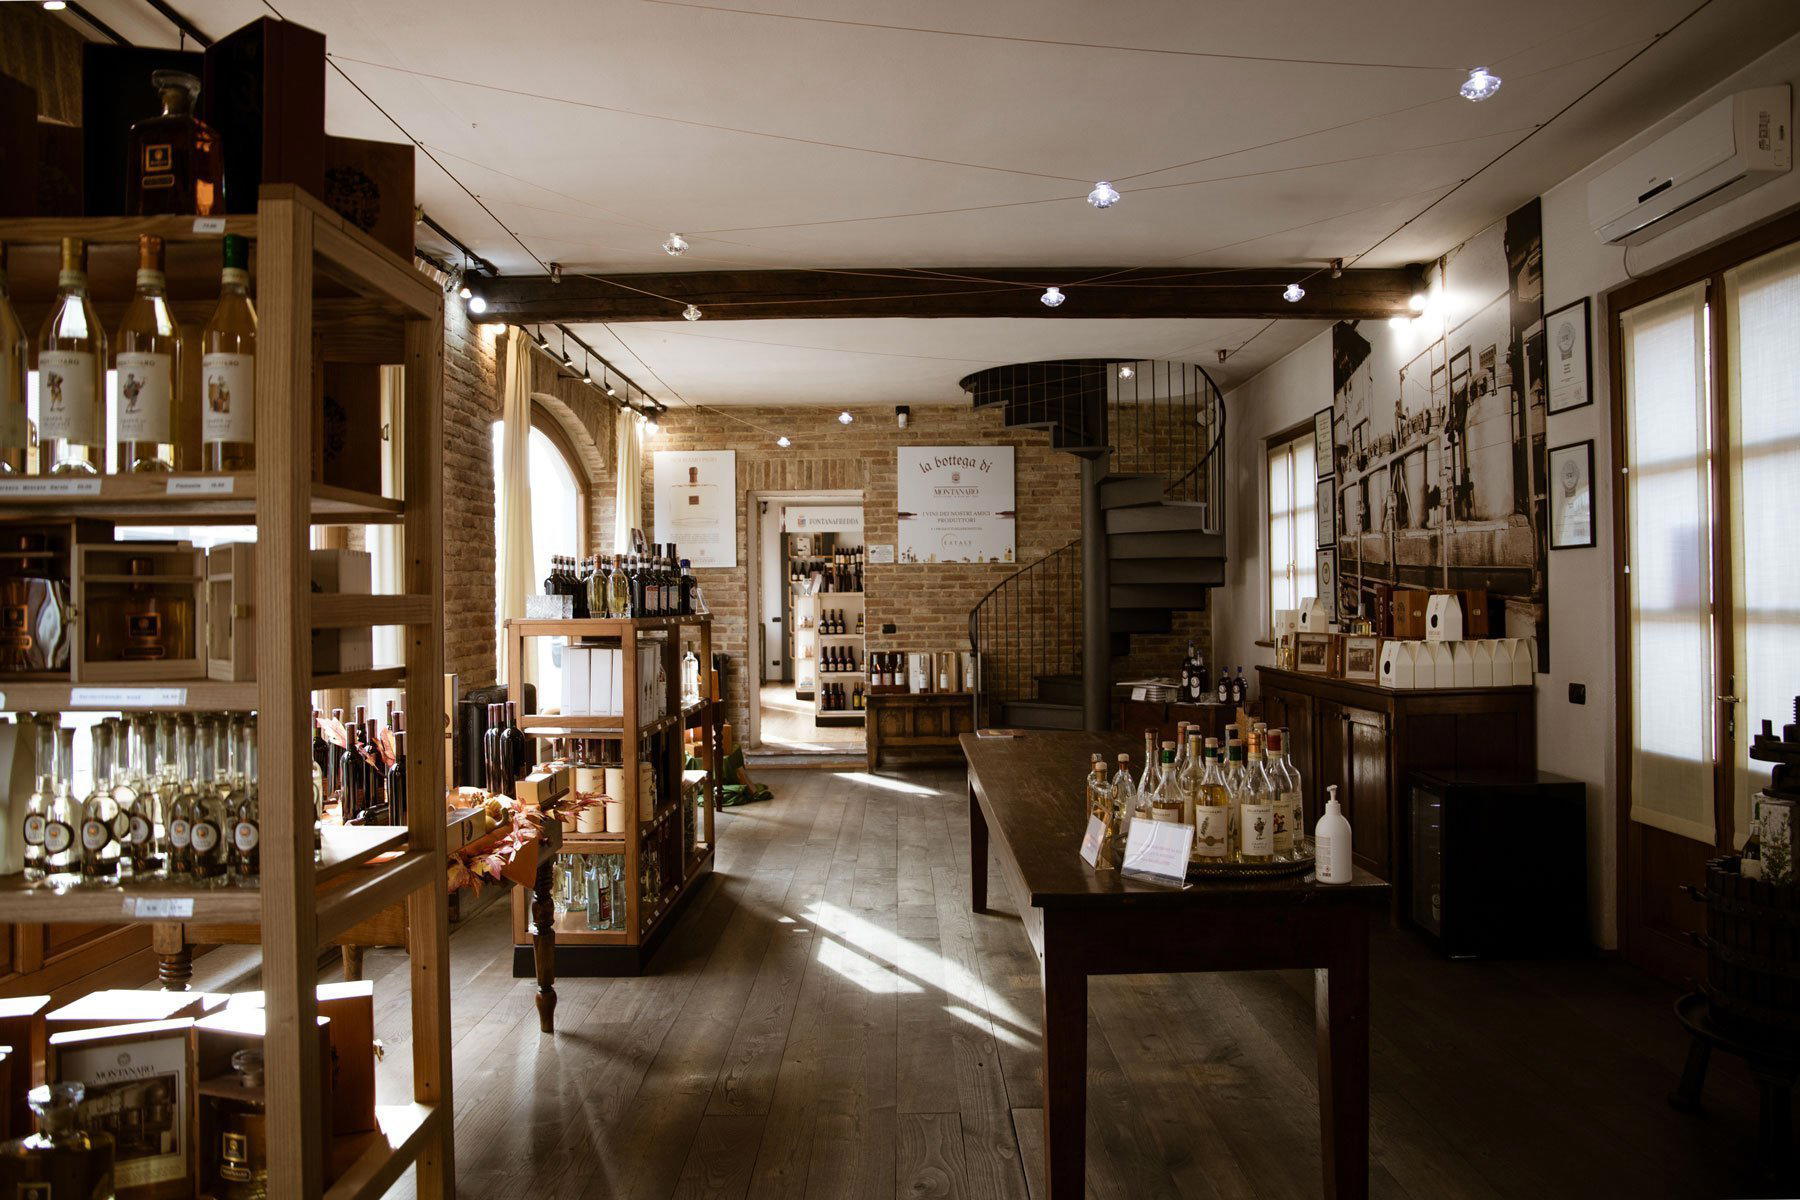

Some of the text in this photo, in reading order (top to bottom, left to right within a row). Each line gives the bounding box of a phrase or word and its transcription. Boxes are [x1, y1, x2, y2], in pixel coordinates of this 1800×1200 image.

[919, 456, 993, 474] la bottega di
[809, 518, 859, 526] FONTANAFREDDA
[95, 1064, 155, 1080] MONTANARO
